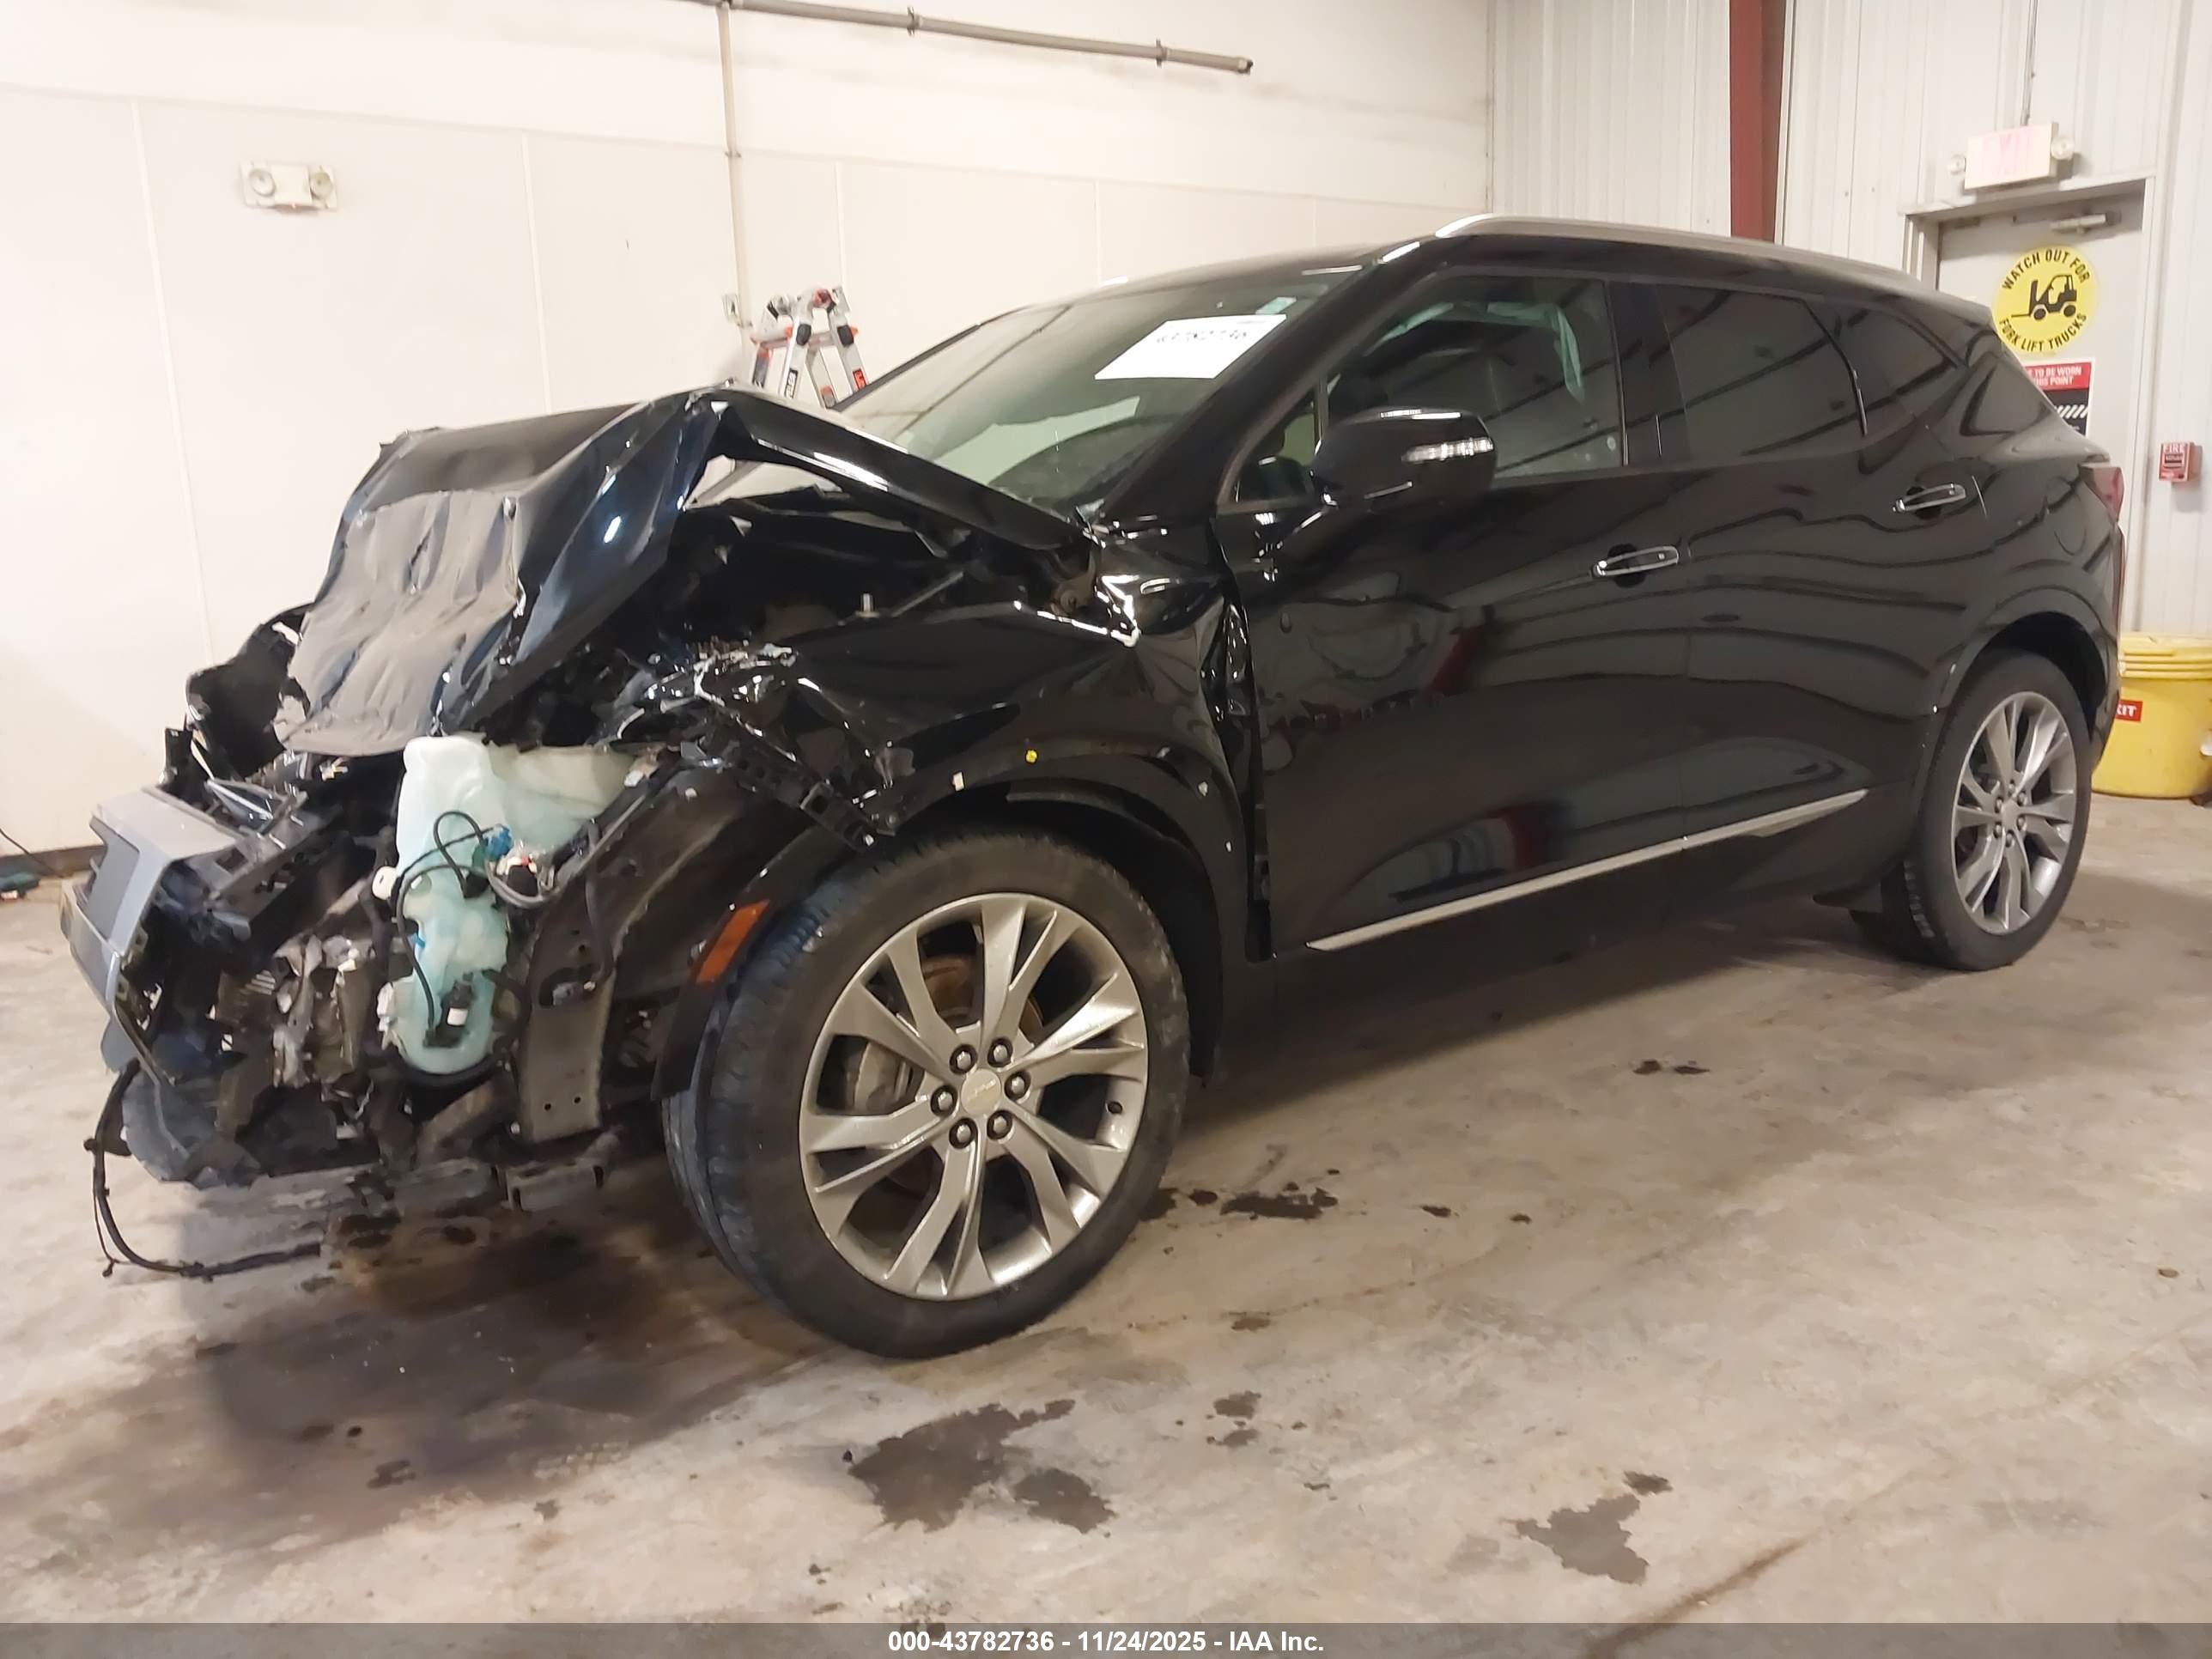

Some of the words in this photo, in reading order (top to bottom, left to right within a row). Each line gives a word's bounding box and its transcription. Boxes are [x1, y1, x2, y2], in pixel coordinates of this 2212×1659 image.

[2002, 252, 2040, 289] WATCH
[2045, 249, 2070, 264] OUT
[2069, 258, 2090, 283] FOR
[1999, 319, 2021, 346] FORK
[2021, 338, 2044, 352] LIFT
[2048, 313, 2087, 349] TRUCKS
[2033, 368, 2045, 377] TO
[2045, 367, 2057, 376] BE
[2057, 366, 2082, 376] WORN
[2049, 376, 2074, 386] POINT
[2163, 442, 2185, 453] FIRE
